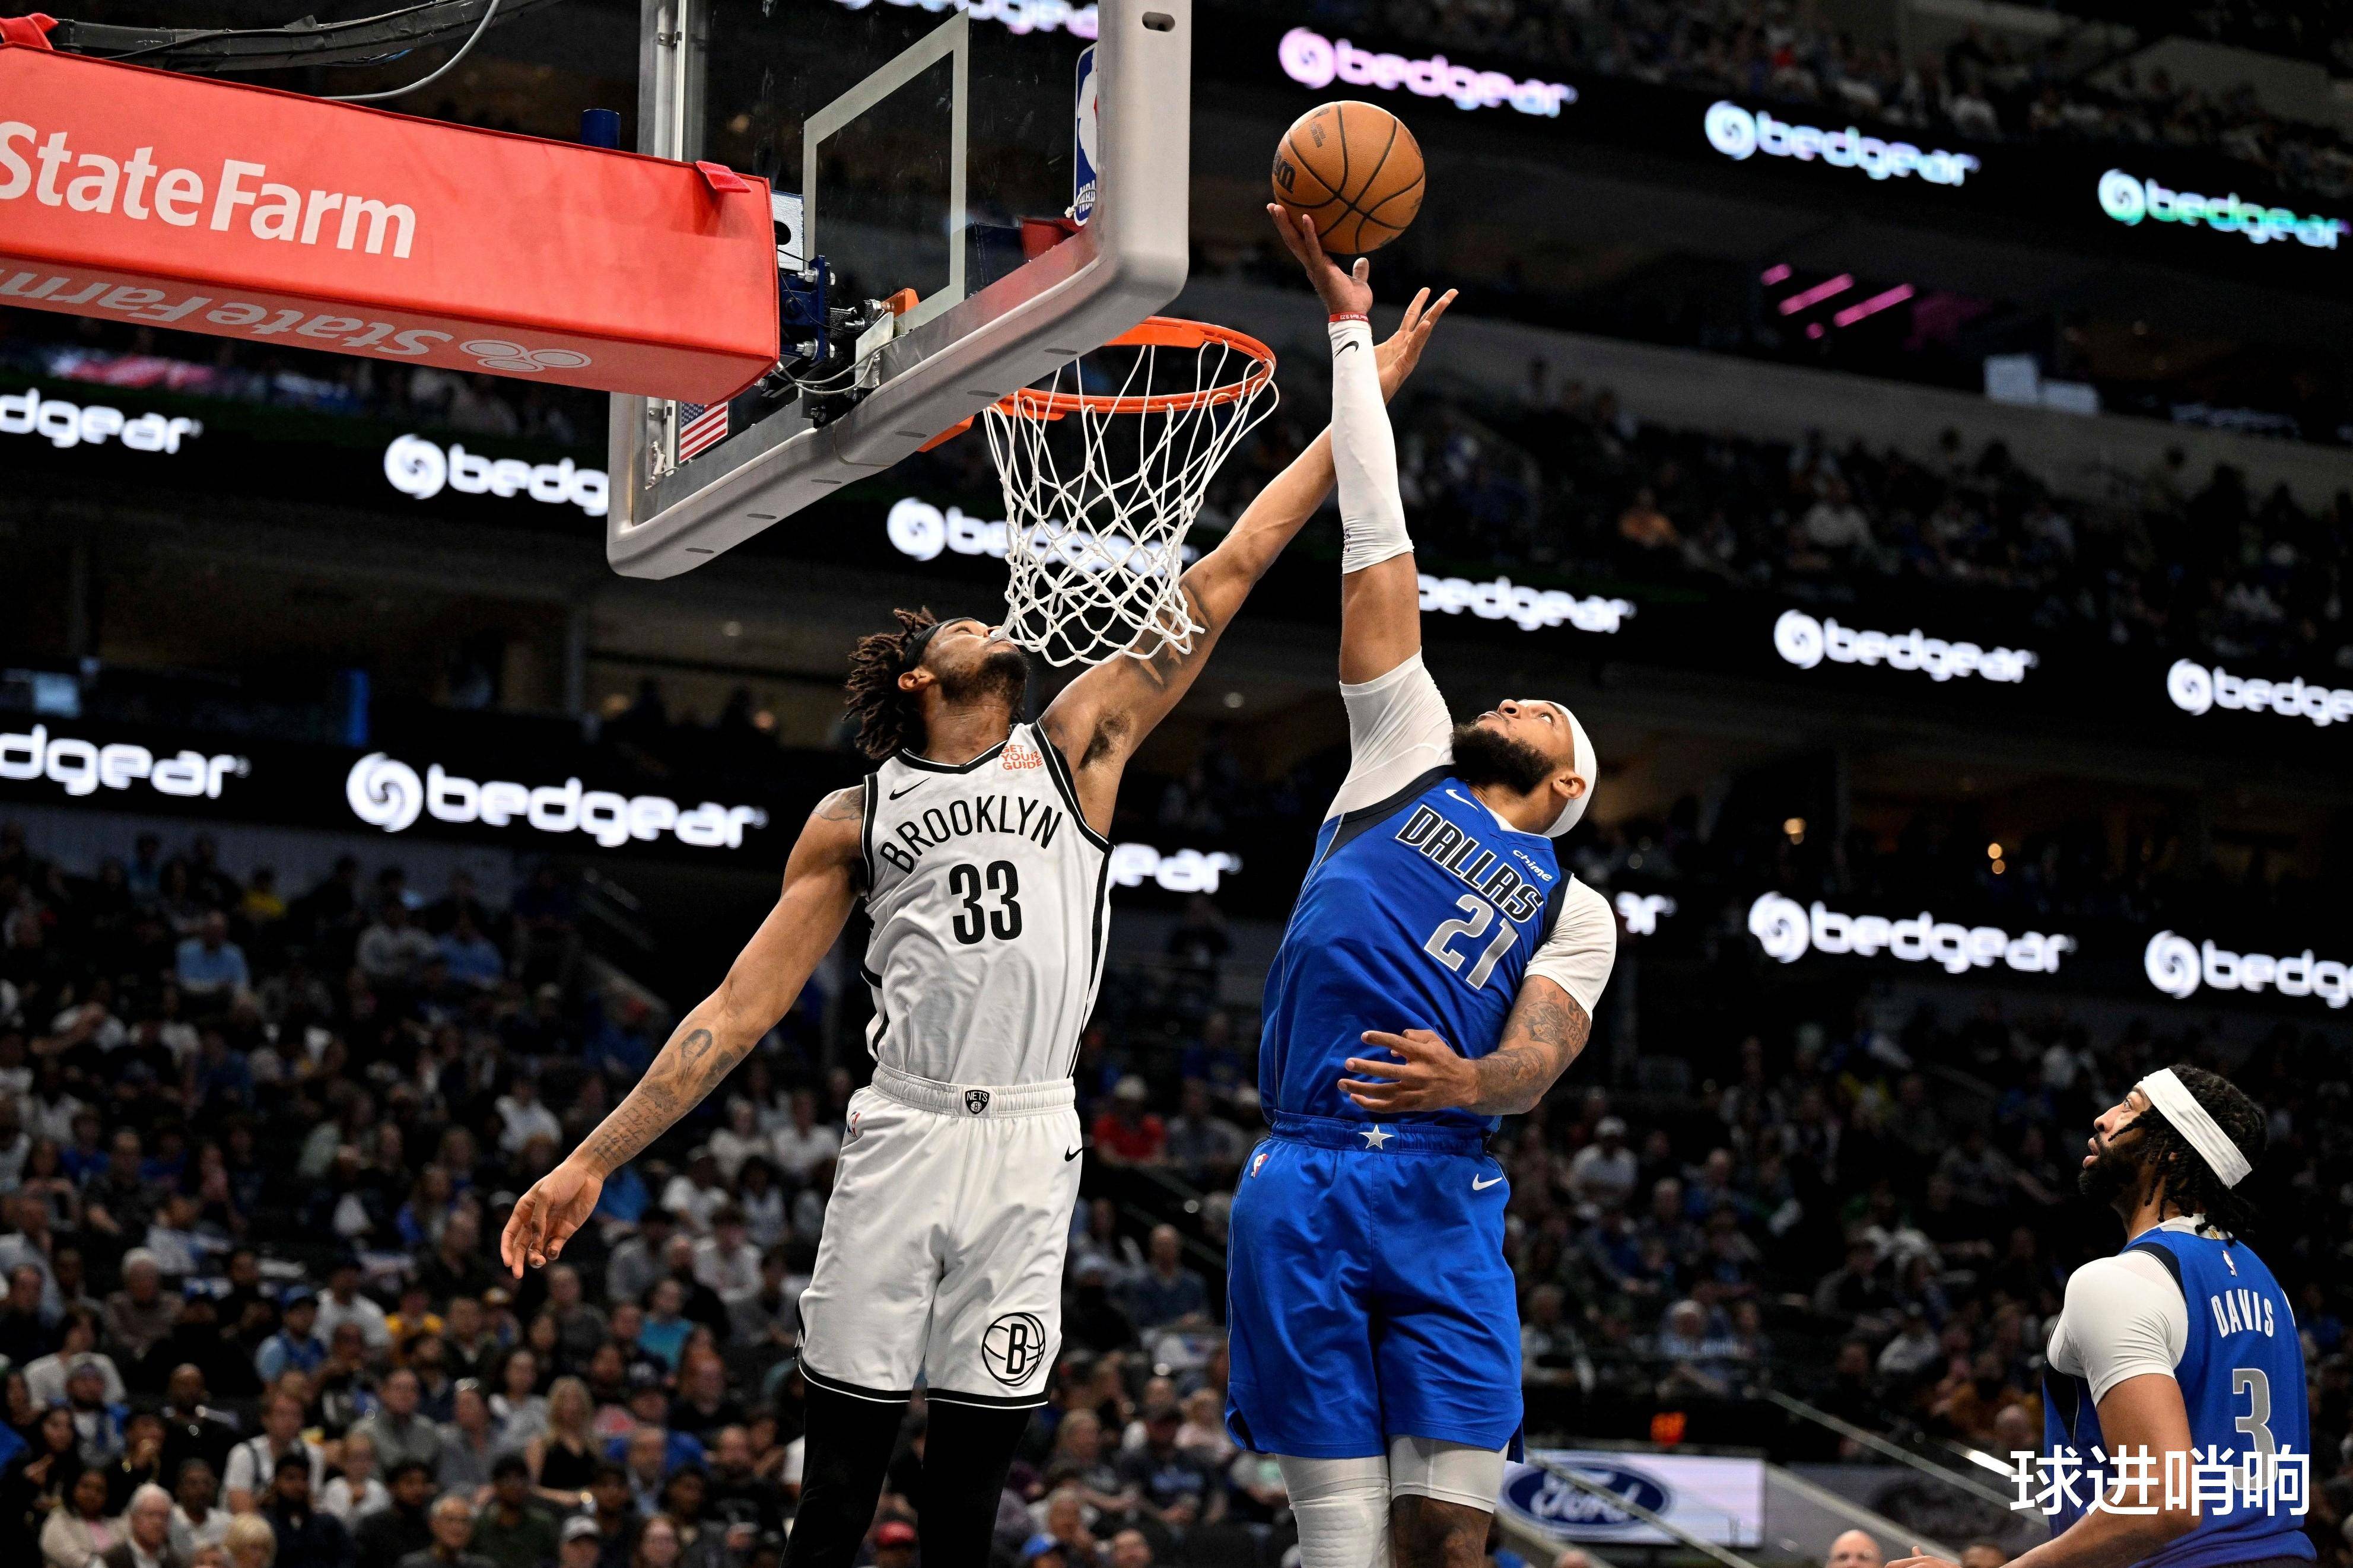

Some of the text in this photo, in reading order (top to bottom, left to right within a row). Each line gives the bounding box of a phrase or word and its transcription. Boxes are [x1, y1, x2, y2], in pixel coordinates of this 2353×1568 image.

[1337, 40, 1567, 119] bedgear
[1757, 111, 1973, 186] bedgear
[0, 120, 416, 259] State Farm
[2145, 179, 2345, 249] bedgear
[1825, 618, 2030, 683] bedgear
[1001, 745, 1024, 754] GET
[1001, 750, 1039, 762] YOUR
[1002, 757, 1043, 771] GUIDE
[426, 763, 759, 849] bedgear
[880, 795, 1063, 874] BROOKLYN
[1394, 804, 1544, 924] DALLAS
[1512, 848, 1553, 882] chime
[949, 860, 1023, 945] 33
[1811, 901, 2067, 974] bedgear
[1424, 894, 1519, 991] 21
[966, 1091, 988, 1102] NETS
[2210, 1288, 2274, 1338] DAVIS
[1006, 1323, 1028, 1375] B
[2233, 1367, 2278, 1491] 3
[1530, 1465, 1642, 1524] Ford
